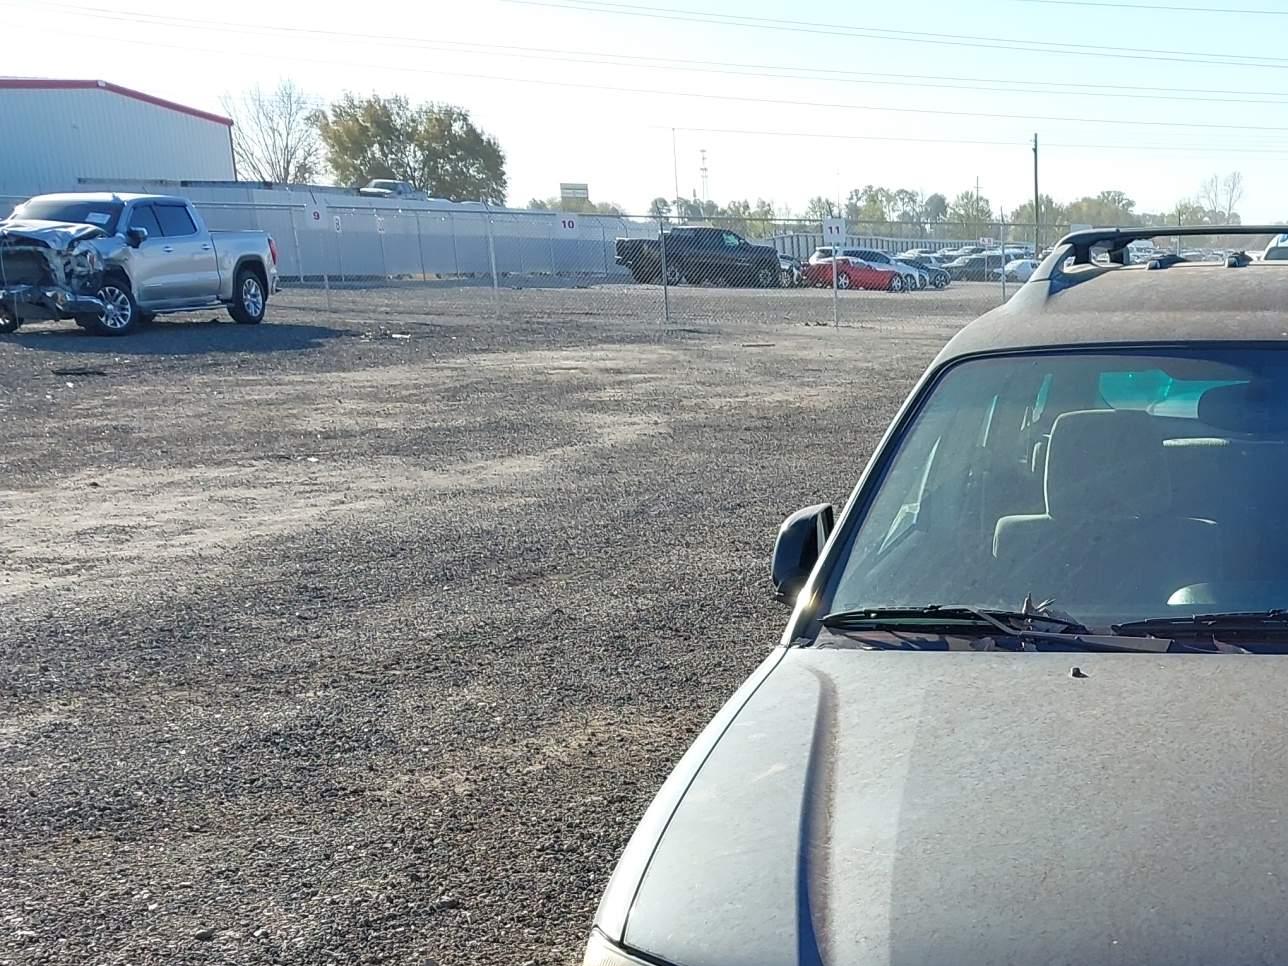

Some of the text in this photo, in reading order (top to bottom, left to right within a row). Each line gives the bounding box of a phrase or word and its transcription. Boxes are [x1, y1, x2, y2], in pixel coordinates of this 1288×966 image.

[312, 210, 320, 221] 9
[561, 219, 575, 229] 10
[827, 225, 840, 235] 11
